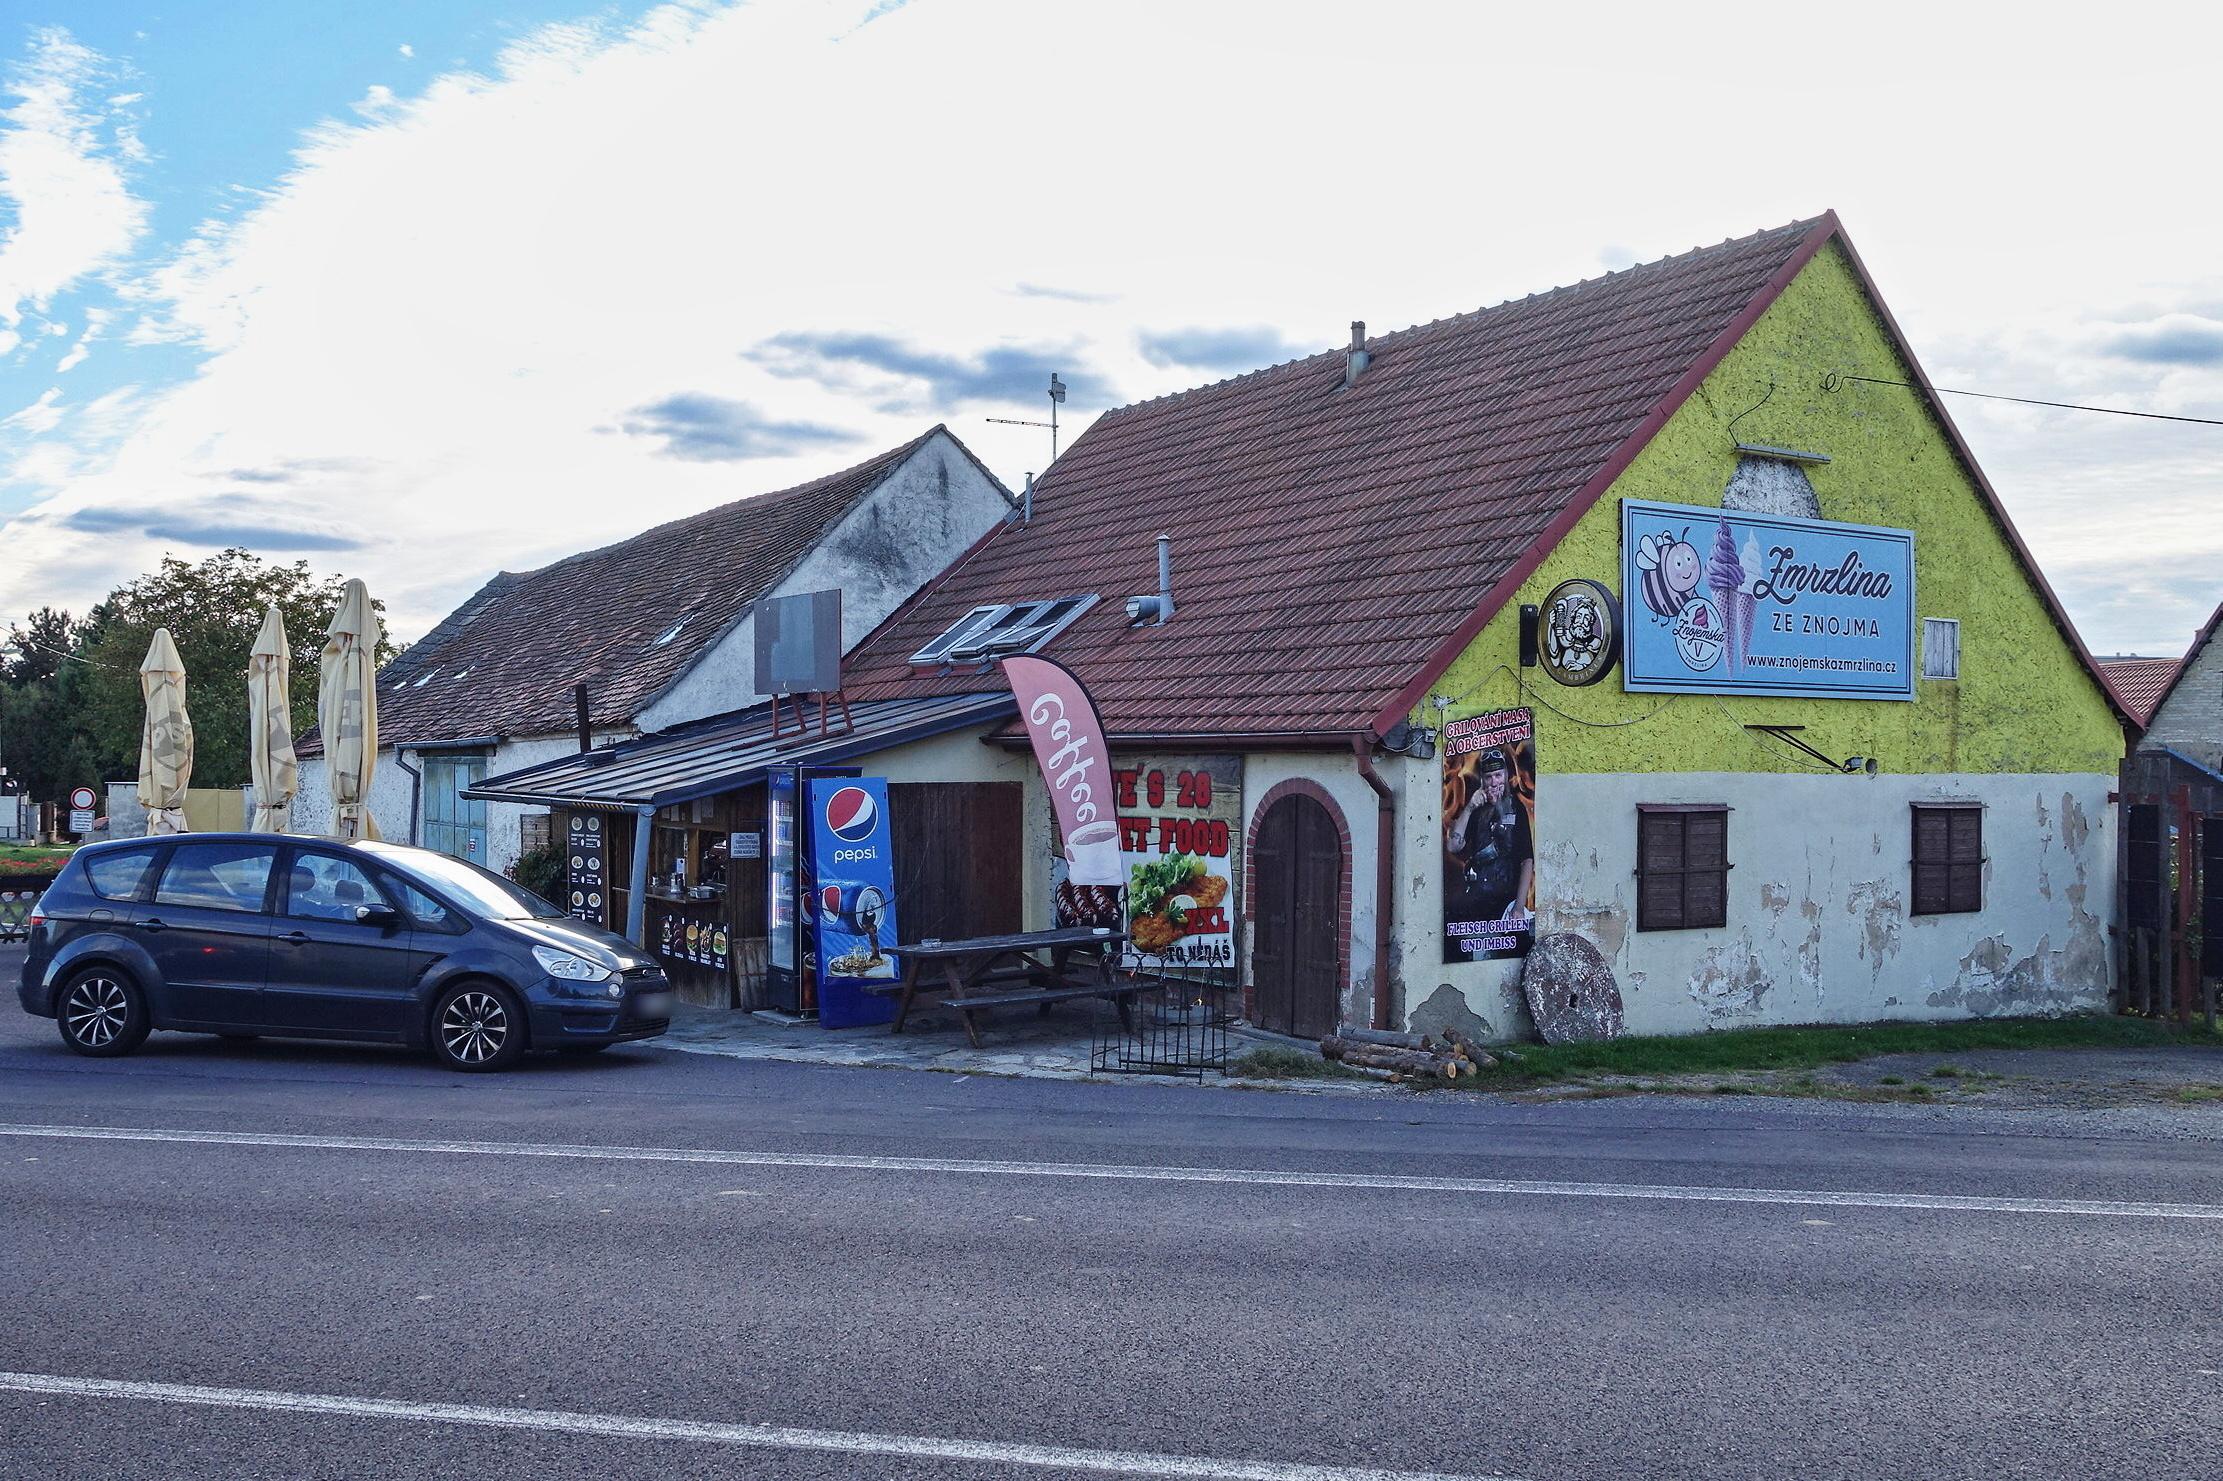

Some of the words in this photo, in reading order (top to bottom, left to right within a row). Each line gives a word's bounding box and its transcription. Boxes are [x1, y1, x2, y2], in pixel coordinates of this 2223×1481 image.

[1753, 546, 1892, 604] Zmrzlina
[1672, 619, 1726, 645] Znojemská
[1772, 612, 1793, 632] ZE
[1802, 615, 1880, 638] ZNOJMA
[1747, 655, 1896, 673] www.znojemskazmrzlina.cz
[1446, 710, 1501, 738] GRILOVÁNÍ
[1502, 708, 1531, 727] MASA
[1446, 741, 1456, 756] A
[1456, 721, 1531, 754] OBČERSTVENÍ
[1031, 693, 1097, 823] Coffee
[1177, 771, 1212, 808] 28
[1159, 817, 1229, 858] FOOD
[834, 845, 876, 864] pepsi
[1183, 906, 1230, 936] XXL
[1447, 920, 1487, 936] FLEISCH
[1488, 918, 1530, 934] GRILLEN
[1166, 945, 1184, 962] TO
[1460, 939, 1482, 952] UND
[1483, 936, 1517, 950] IMBISS
